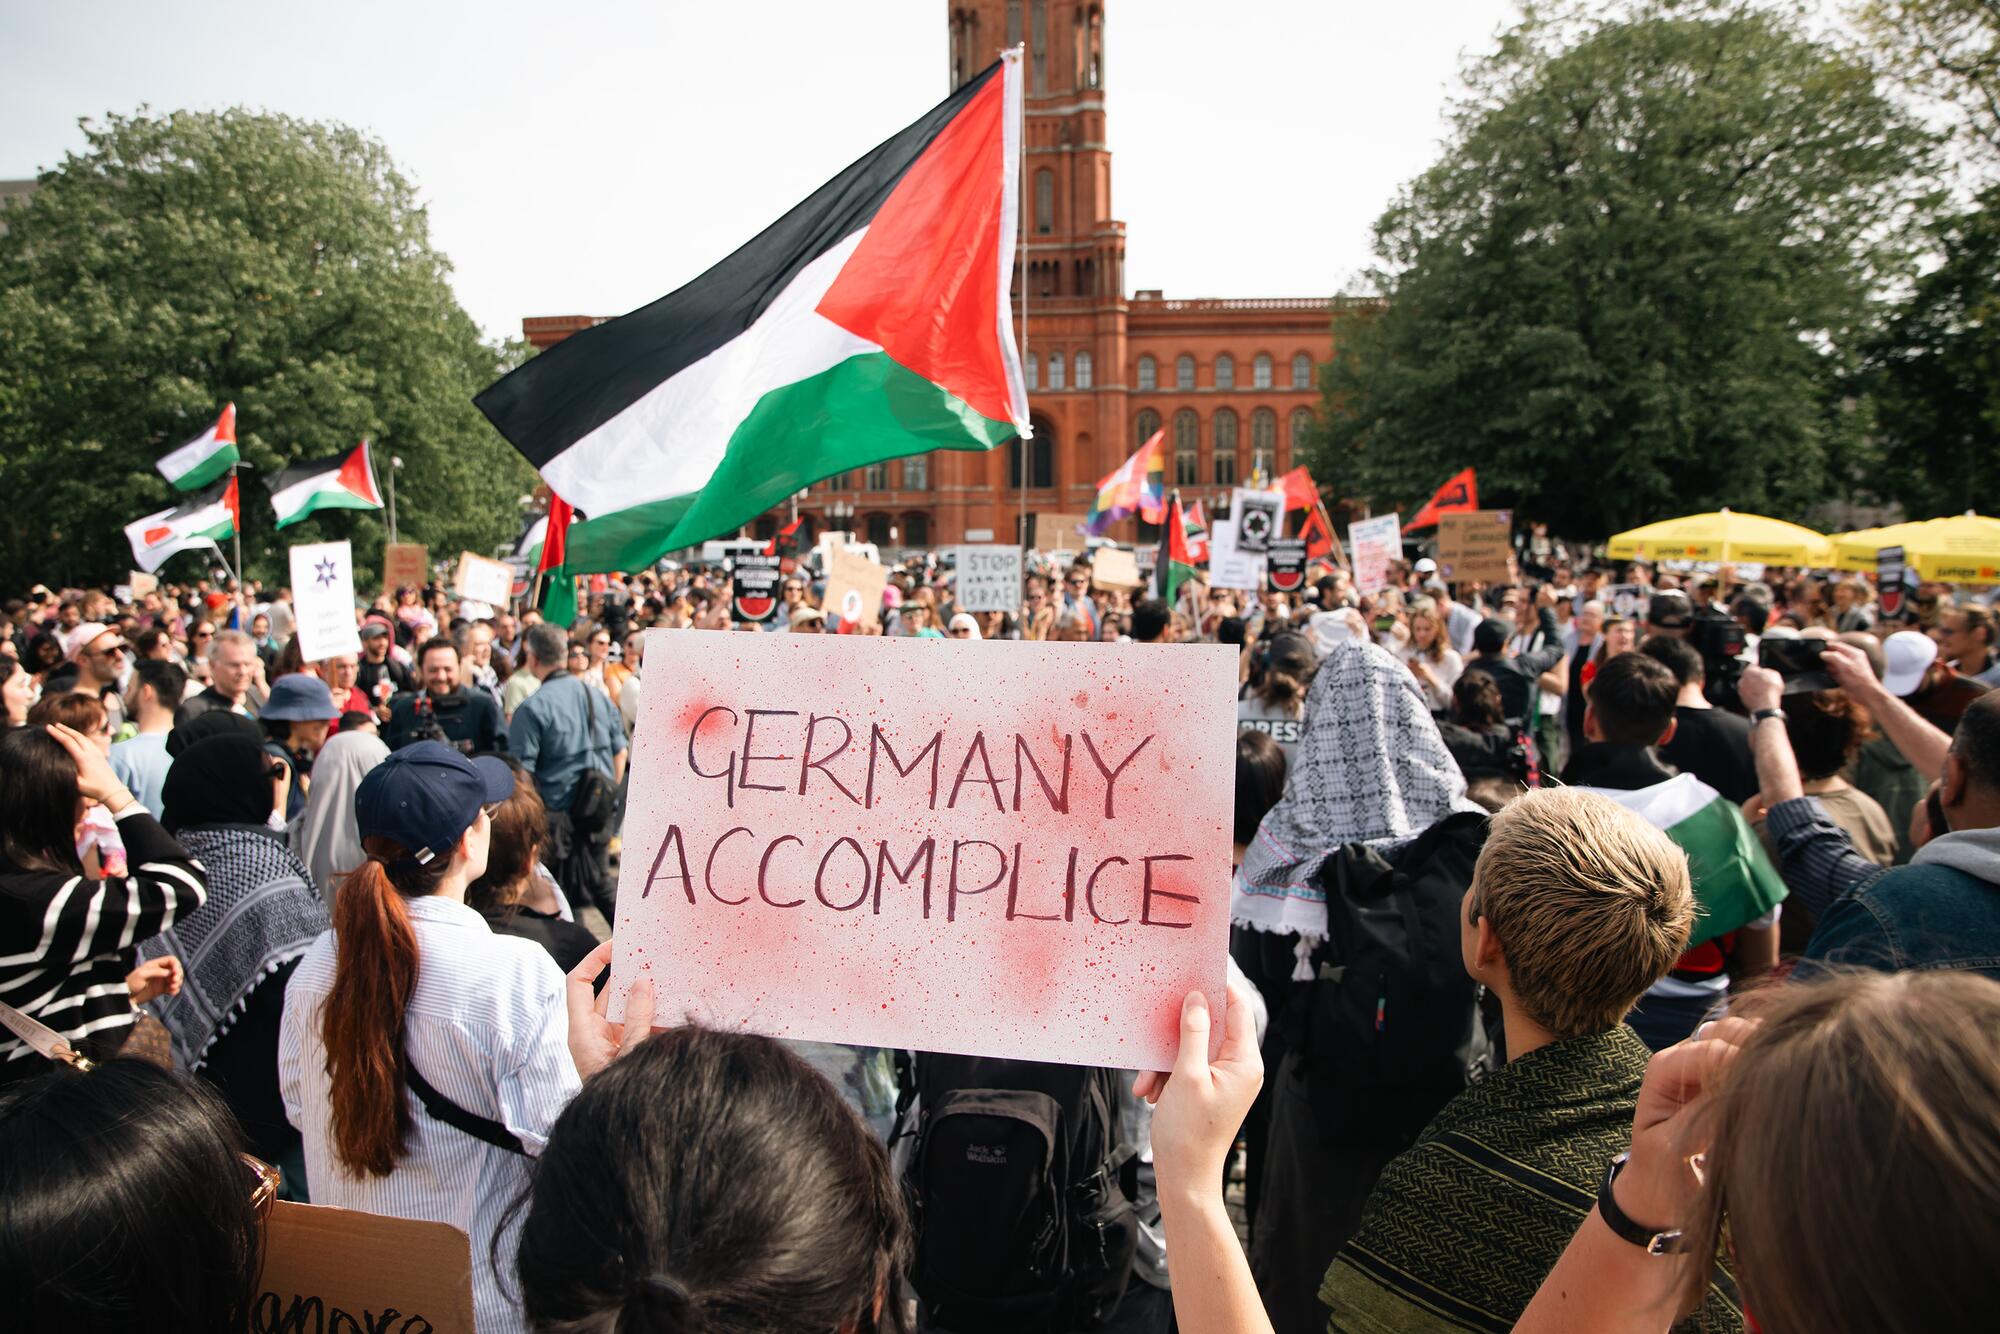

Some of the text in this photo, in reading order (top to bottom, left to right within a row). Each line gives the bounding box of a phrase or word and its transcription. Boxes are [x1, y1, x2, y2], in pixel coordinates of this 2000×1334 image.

[962, 586, 1020, 607] ISRAEL
[688, 706, 1155, 819] GERMANY
[1240, 720, 1304, 742] PRES
[642, 824, 1200, 929] ACCOMPLICE
